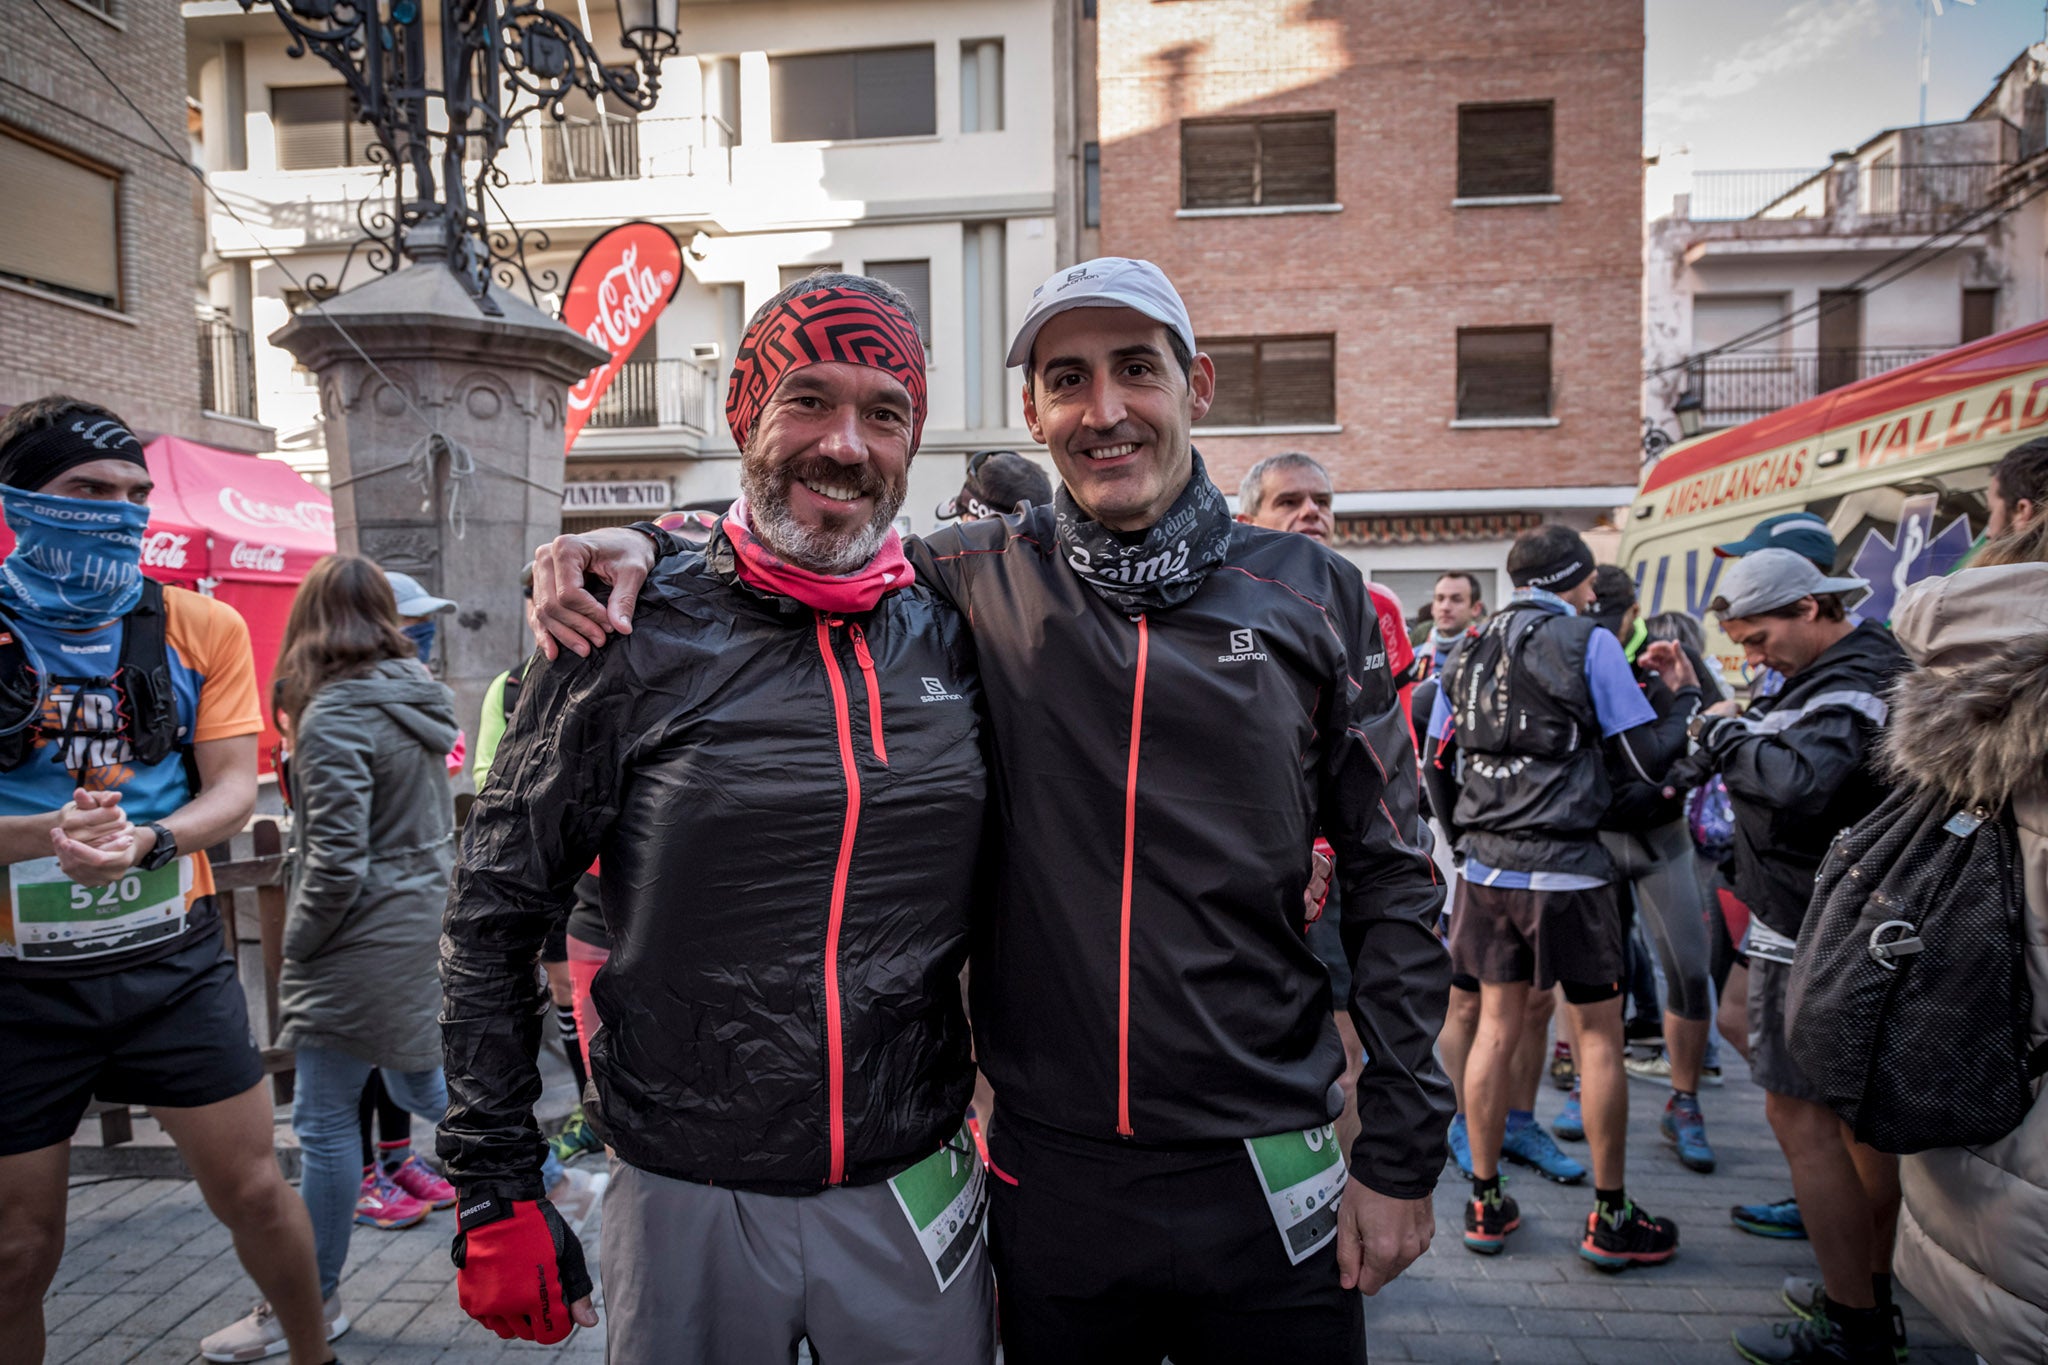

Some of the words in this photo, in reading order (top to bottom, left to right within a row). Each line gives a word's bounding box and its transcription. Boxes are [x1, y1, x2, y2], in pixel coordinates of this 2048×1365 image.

[1662, 448, 1808, 521] AMBULANCIAS
[34, 504, 122, 524] BROOKS
[1152, 528, 1168, 551] 3
[1164, 504, 1197, 537] cims
[230, 541, 286, 572] Coca-Cola
[1218, 652, 1268, 663] salomon
[920, 693, 963, 704] salomon
[71, 876, 142, 909] 520
